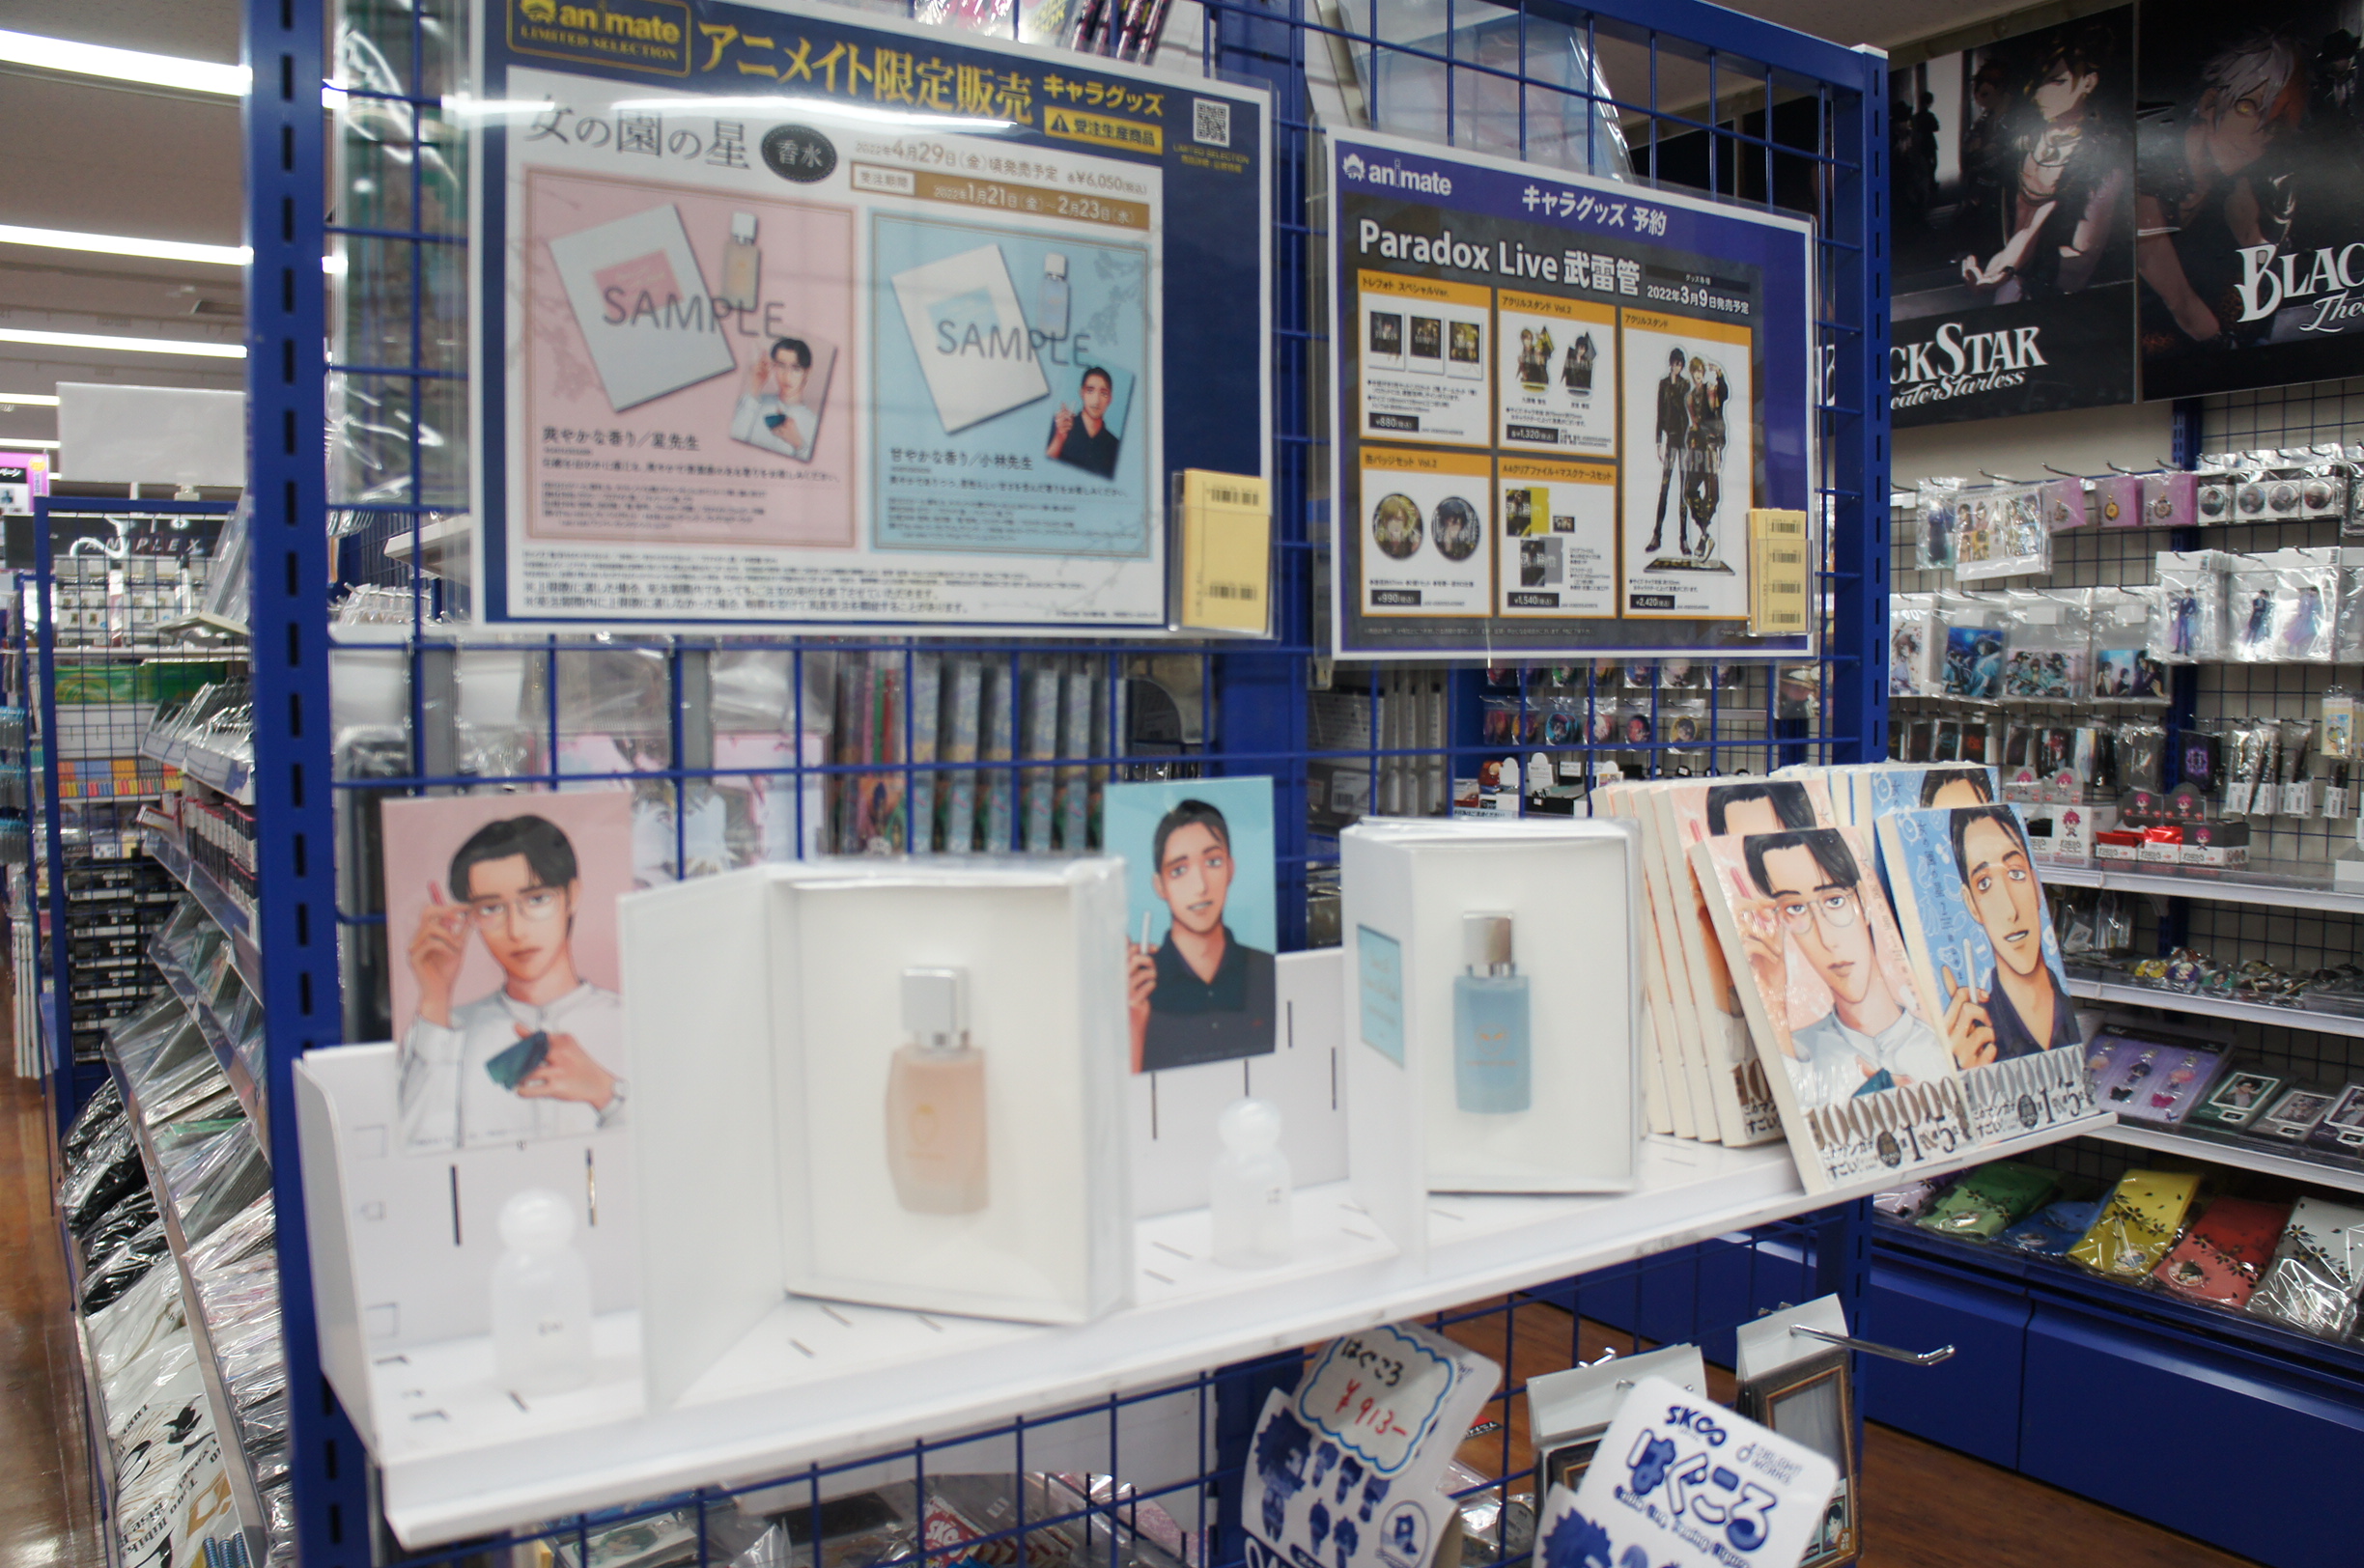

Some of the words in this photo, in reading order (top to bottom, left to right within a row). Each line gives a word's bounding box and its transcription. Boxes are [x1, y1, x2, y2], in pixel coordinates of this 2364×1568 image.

[521, 24, 589, 46] LIMITED
[592, 38, 677, 61] SELECTION
[560, 0, 681, 44] animate
[698, 21, 1033, 125] アニメイト限定販売
[1043, 74, 1165, 117] キャラグッズ
[523, 94, 751, 171] 女の園の星
[778, 140, 823, 169] 香水
[1074, 118, 1156, 149] 受注生産商品
[1368, 158, 1452, 196] animate
[1522, 184, 1627, 228] キャラグッズ
[1632, 207, 1668, 237] 予約
[1360, 219, 1491, 272] Paradox
[1499, 241, 1559, 282] Live
[1563, 249, 1641, 297] 武雷管
[604, 285, 787, 338] SAMPLE
[1646, 286, 1750, 316] 2022年3月9日発売予定
[937, 319, 1091, 369] SAMPLE
